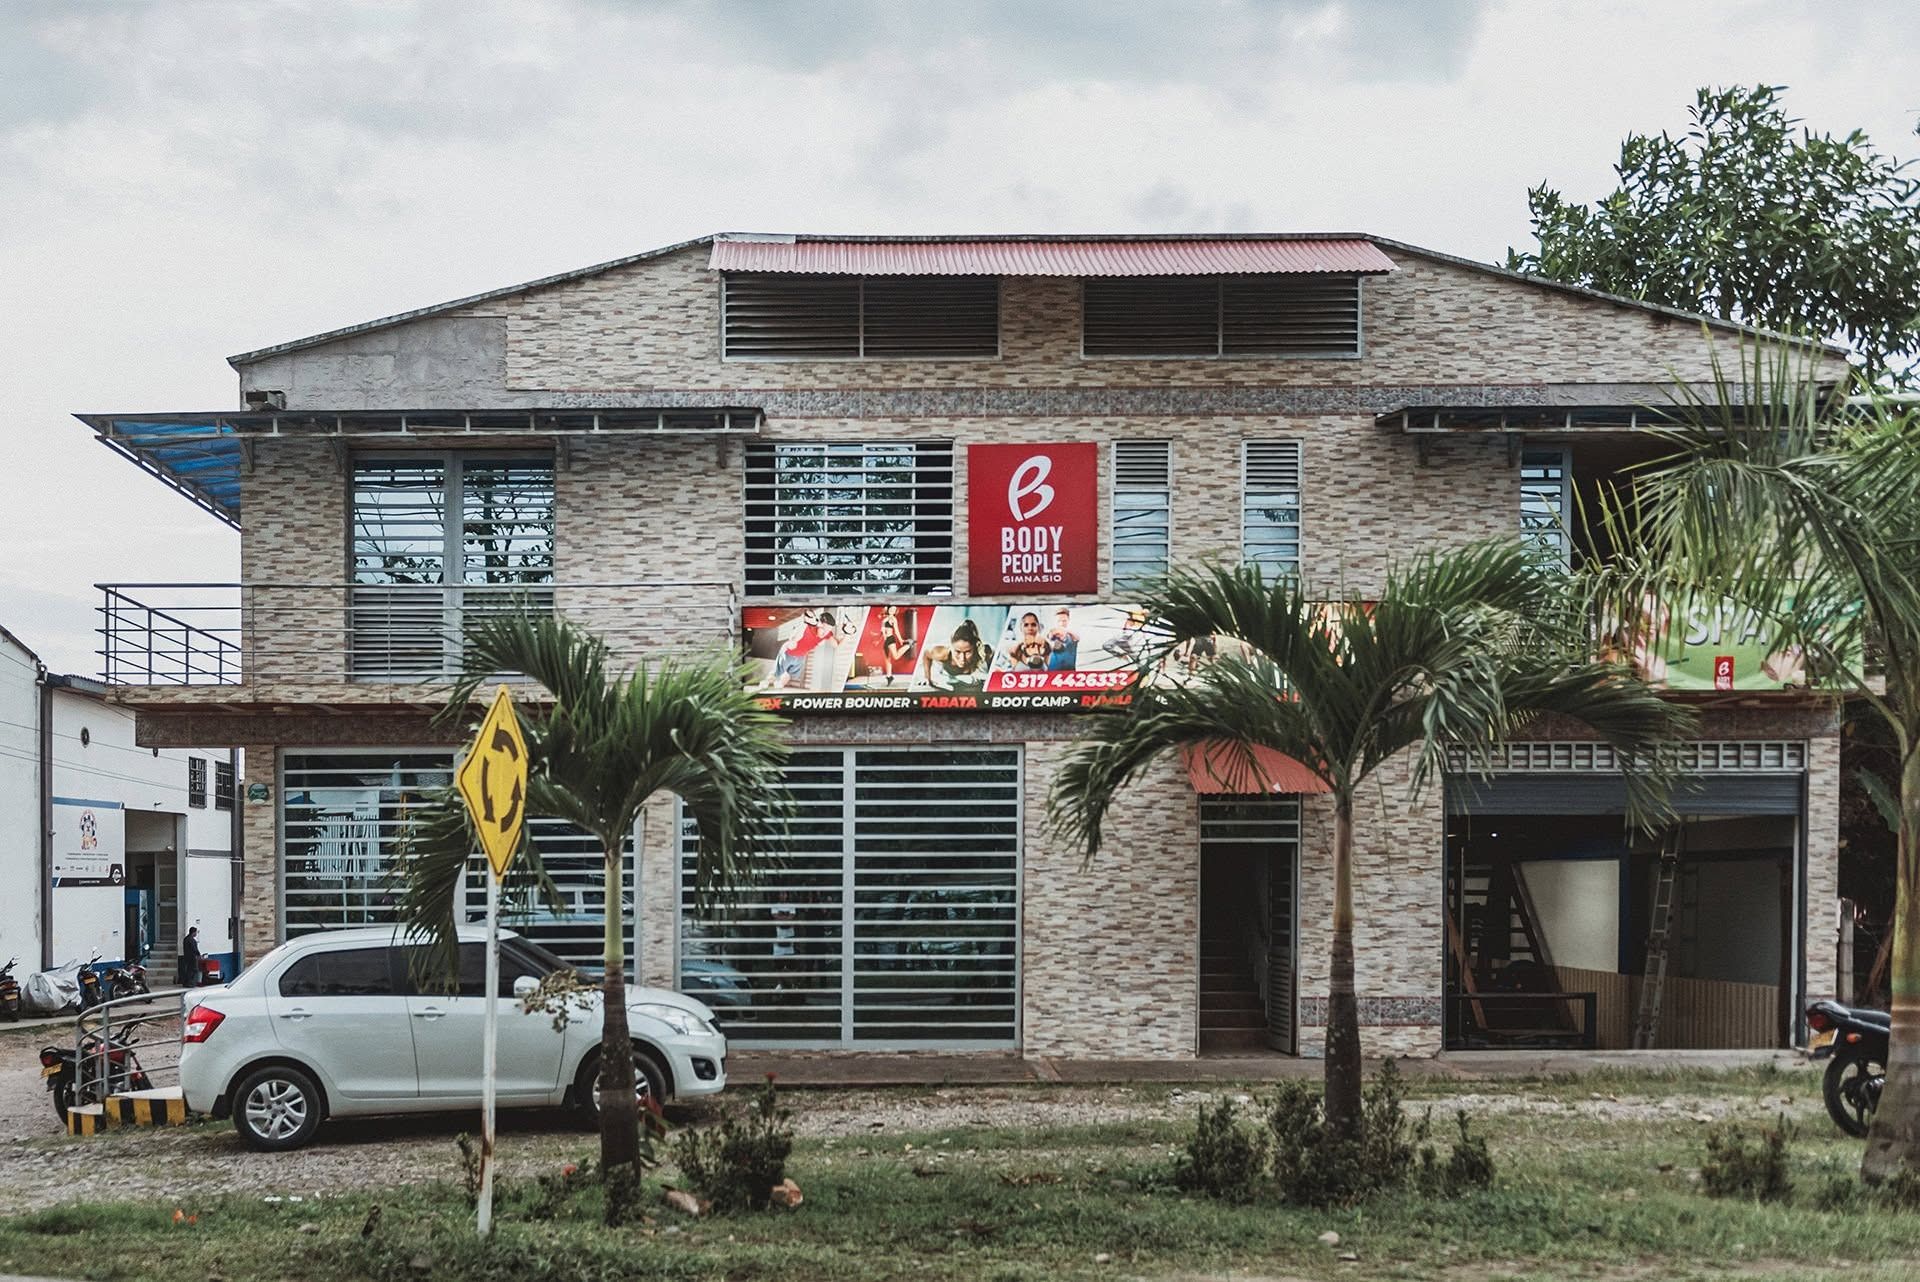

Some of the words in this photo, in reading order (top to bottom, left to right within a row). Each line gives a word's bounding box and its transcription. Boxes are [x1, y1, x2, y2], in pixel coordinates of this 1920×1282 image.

[1001, 526, 1063, 552] BODY
[1001, 553, 1062, 574] PEOPLE
[1002, 575, 1062, 583] GIMNASIO
[1685, 600, 1769, 645] SPA
[1018, 674, 1048, 688] 317
[1051, 673, 1128, 687] 4426332
[793, 699, 843, 709] POWER
[845, 698, 910, 708] BOUNDER
[920, 696, 977, 708] TABATA
[992, 696, 1031, 707] BOOT
[1032, 695, 1070, 707] CAMP
